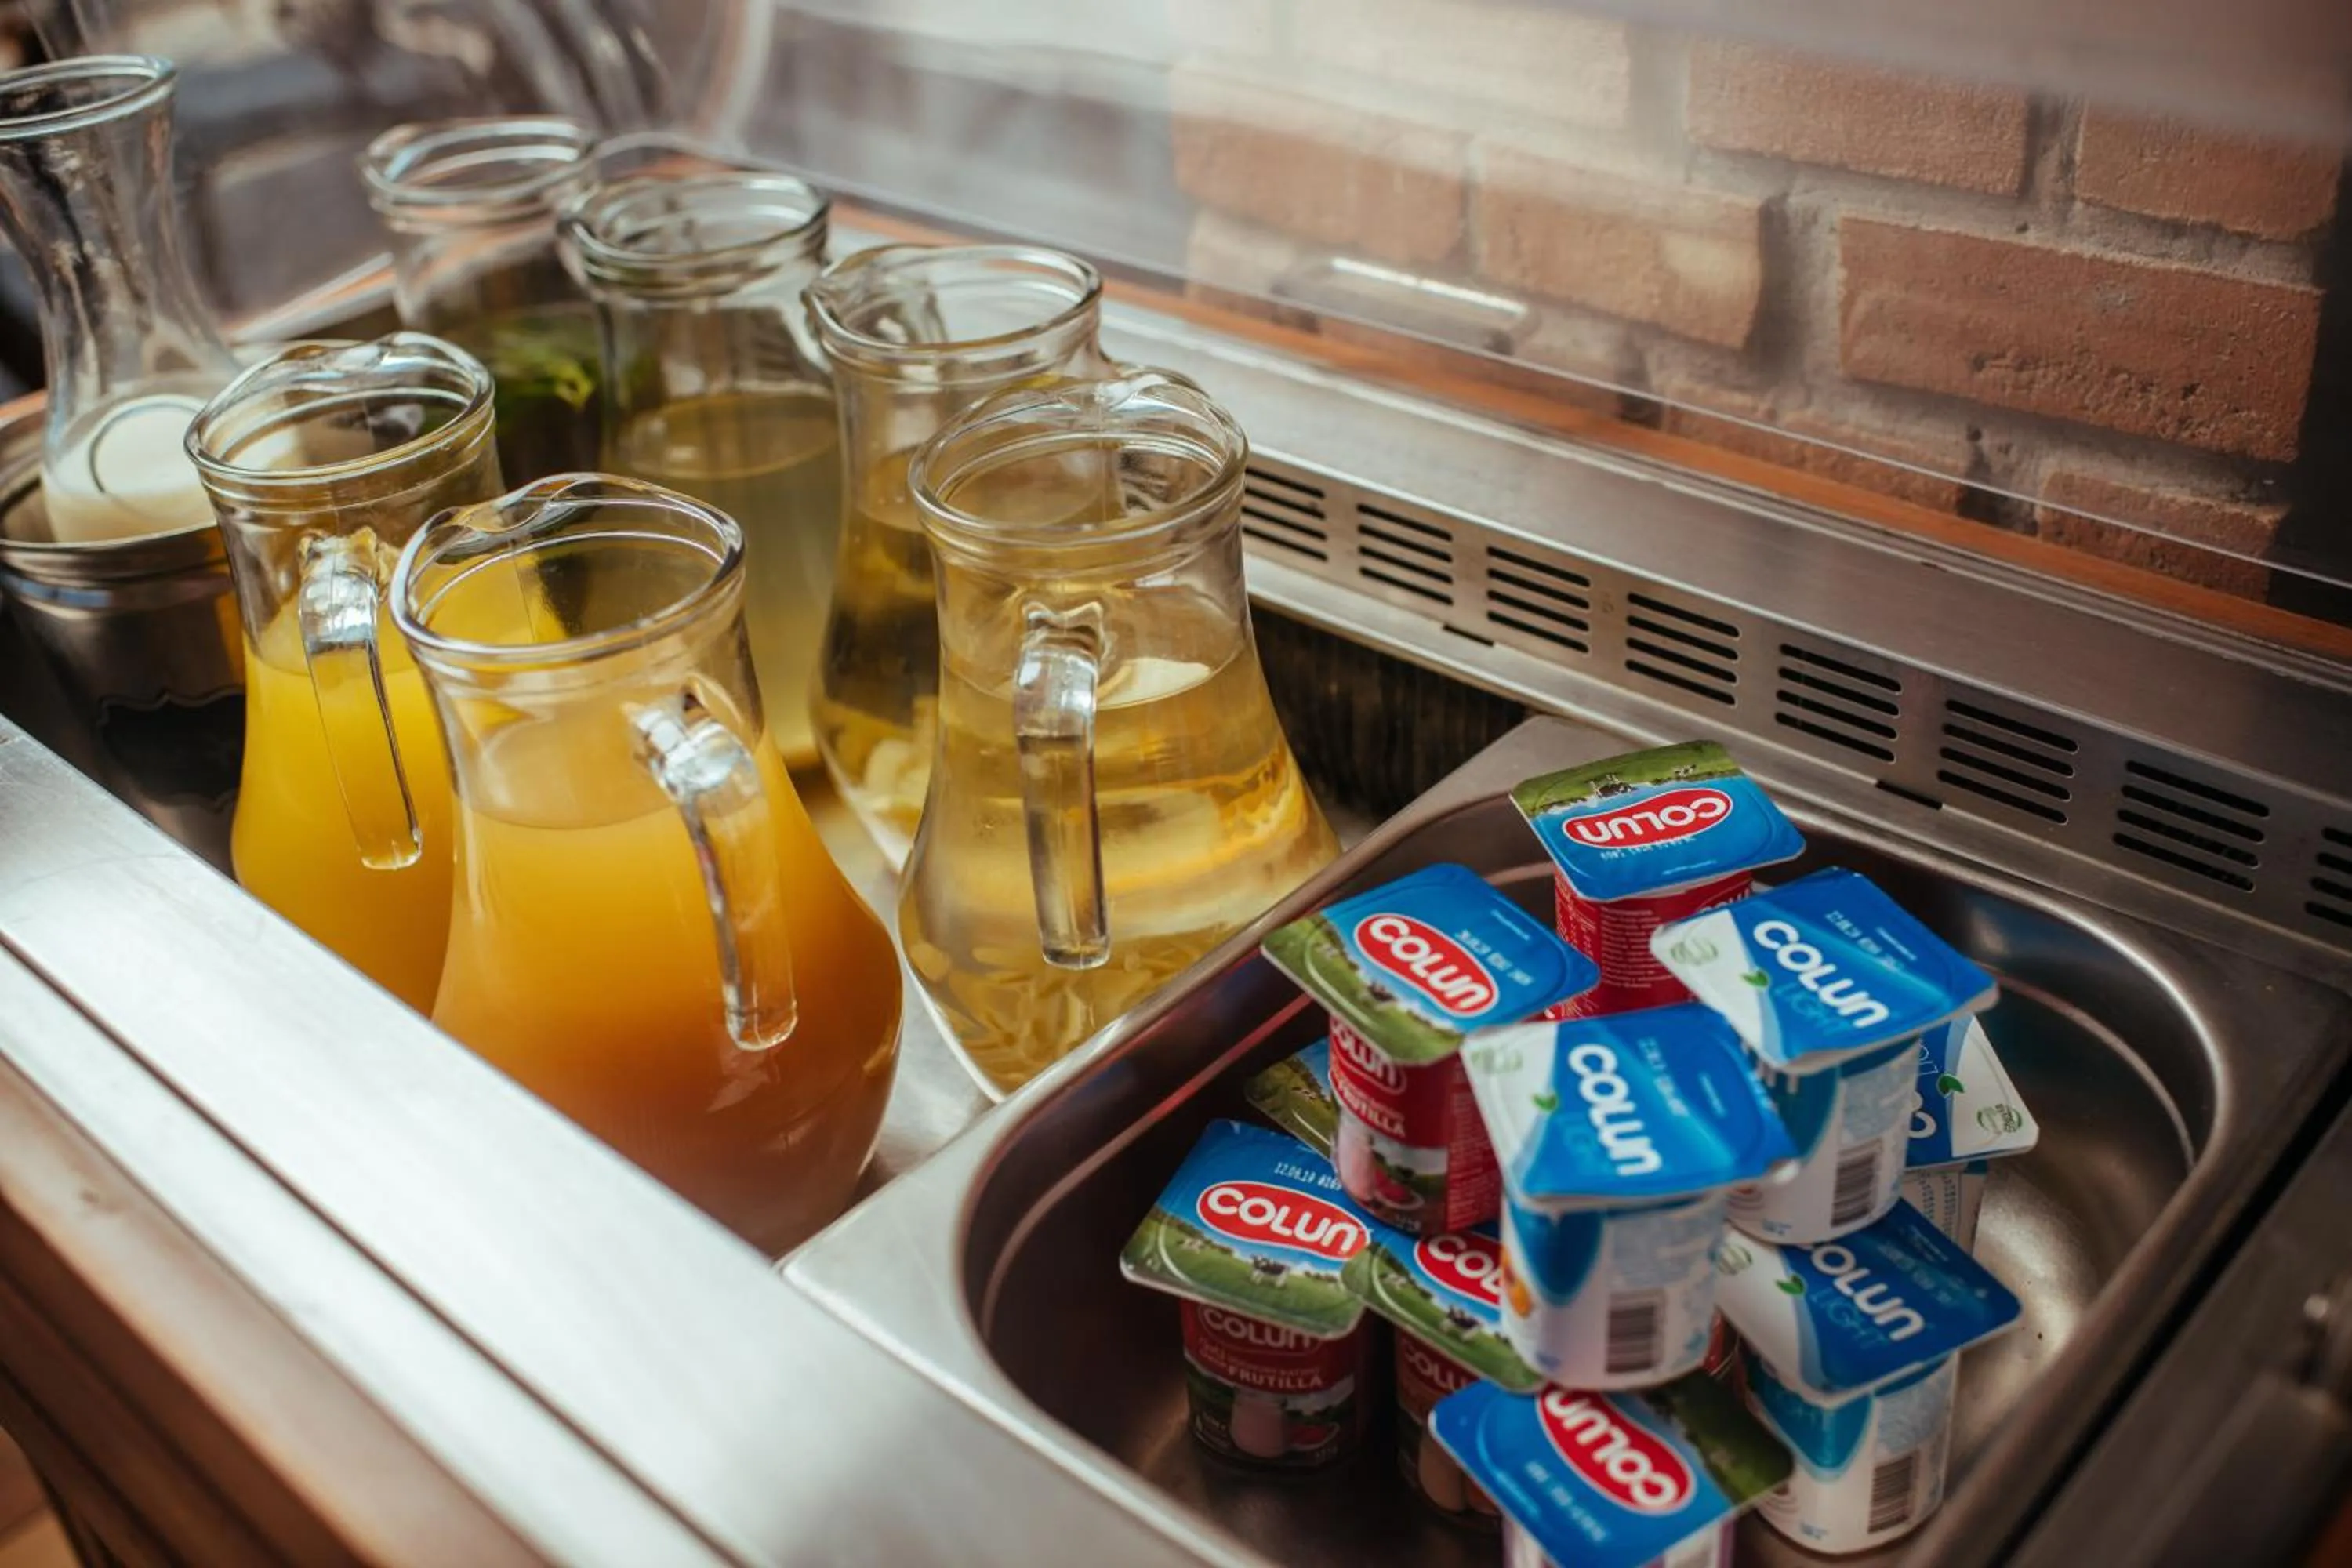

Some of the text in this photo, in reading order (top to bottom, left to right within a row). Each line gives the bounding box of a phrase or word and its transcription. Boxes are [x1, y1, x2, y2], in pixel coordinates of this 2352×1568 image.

[1576, 796, 1726, 844] COLUN
[1369, 916, 1490, 1010] COLUN
[1753, 920, 1889, 1029] COLUN
[1569, 1044, 1663, 1175] COLUN
[1207, 1187, 1359, 1254] COLUN
[1428, 1235, 1503, 1294] COL
[1810, 1244, 1925, 1342] OLUN
